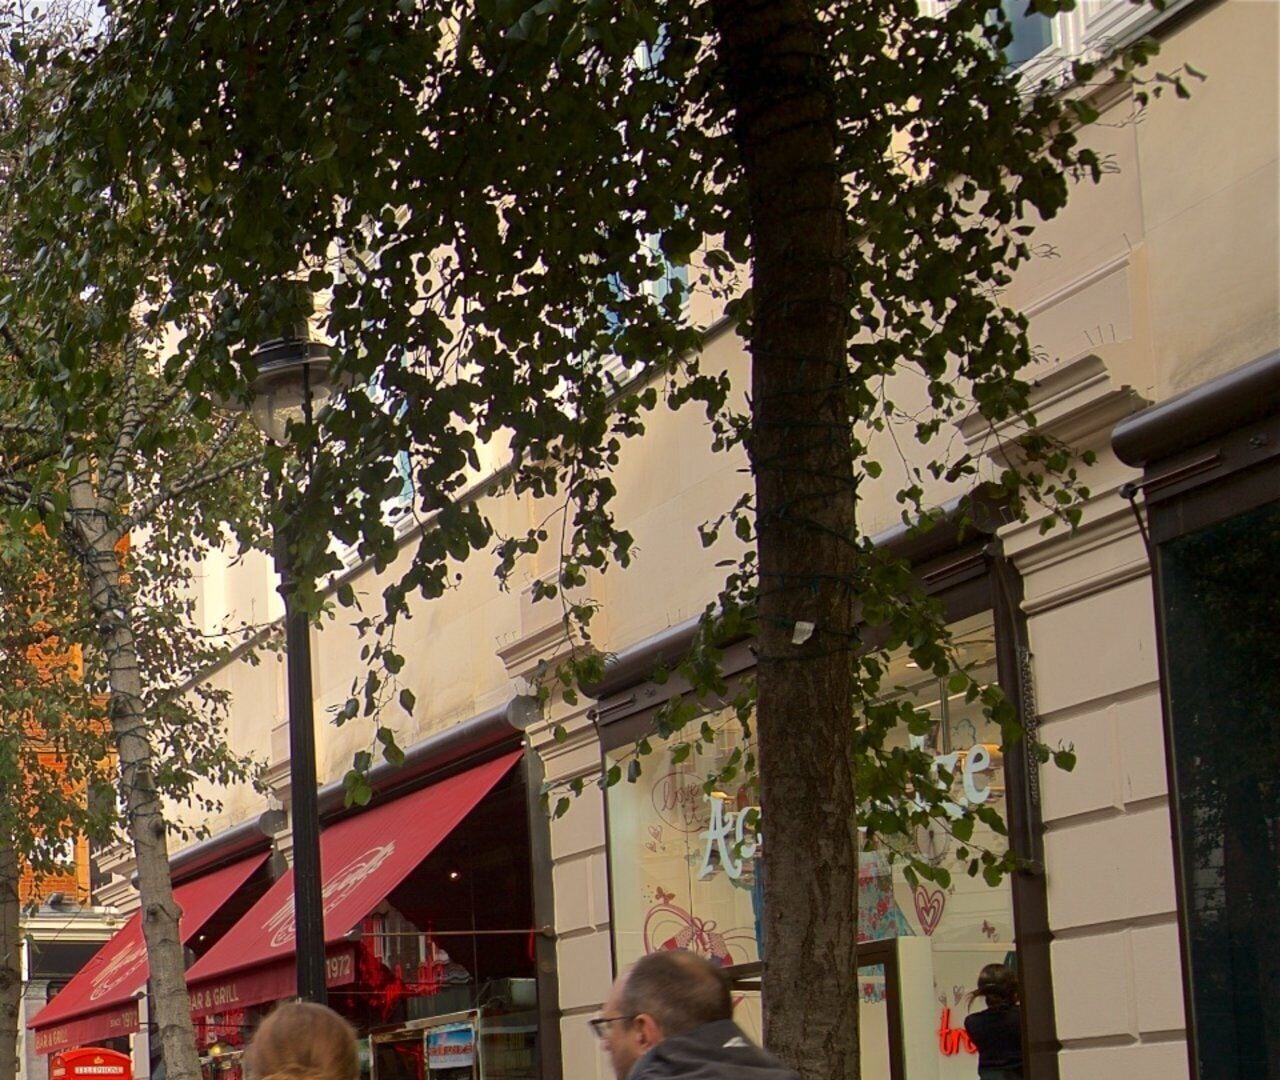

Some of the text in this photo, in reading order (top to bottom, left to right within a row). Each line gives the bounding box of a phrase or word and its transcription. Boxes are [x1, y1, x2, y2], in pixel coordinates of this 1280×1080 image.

[326, 956, 351, 978] 1972
[205, 990, 212, 1008] &
[213, 984, 239, 1006] GRILL
[122, 1011, 138, 1028] 1972
[53, 1028, 68, 1046] GRILL
